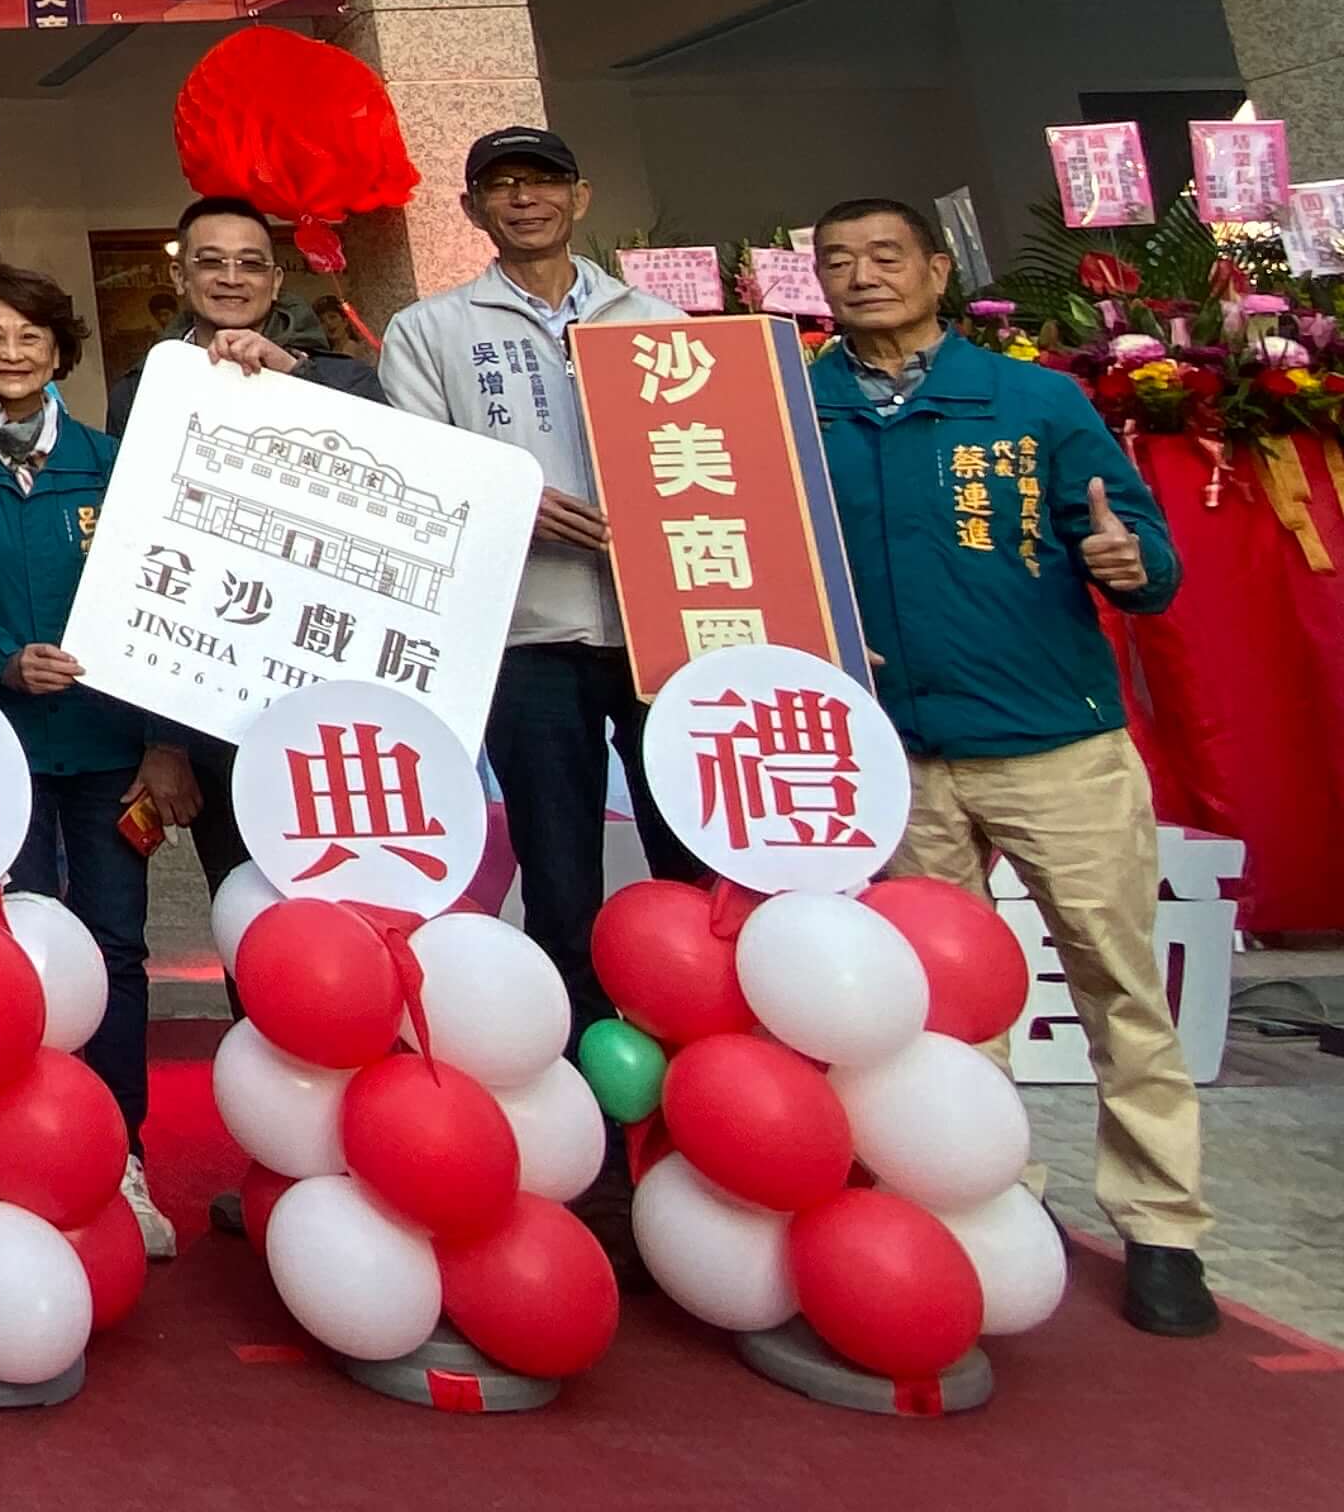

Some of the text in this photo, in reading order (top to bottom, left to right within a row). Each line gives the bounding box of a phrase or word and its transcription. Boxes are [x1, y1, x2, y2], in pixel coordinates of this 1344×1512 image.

[472, 342, 511, 428] 吳增允
[949, 444, 995, 552] 蔡連進
[127, 608, 238, 667] JINSHA
[135, 544, 441, 694] 金沙戲院
[283, 721, 448, 882] 典
[688, 688, 877, 850] 禮
